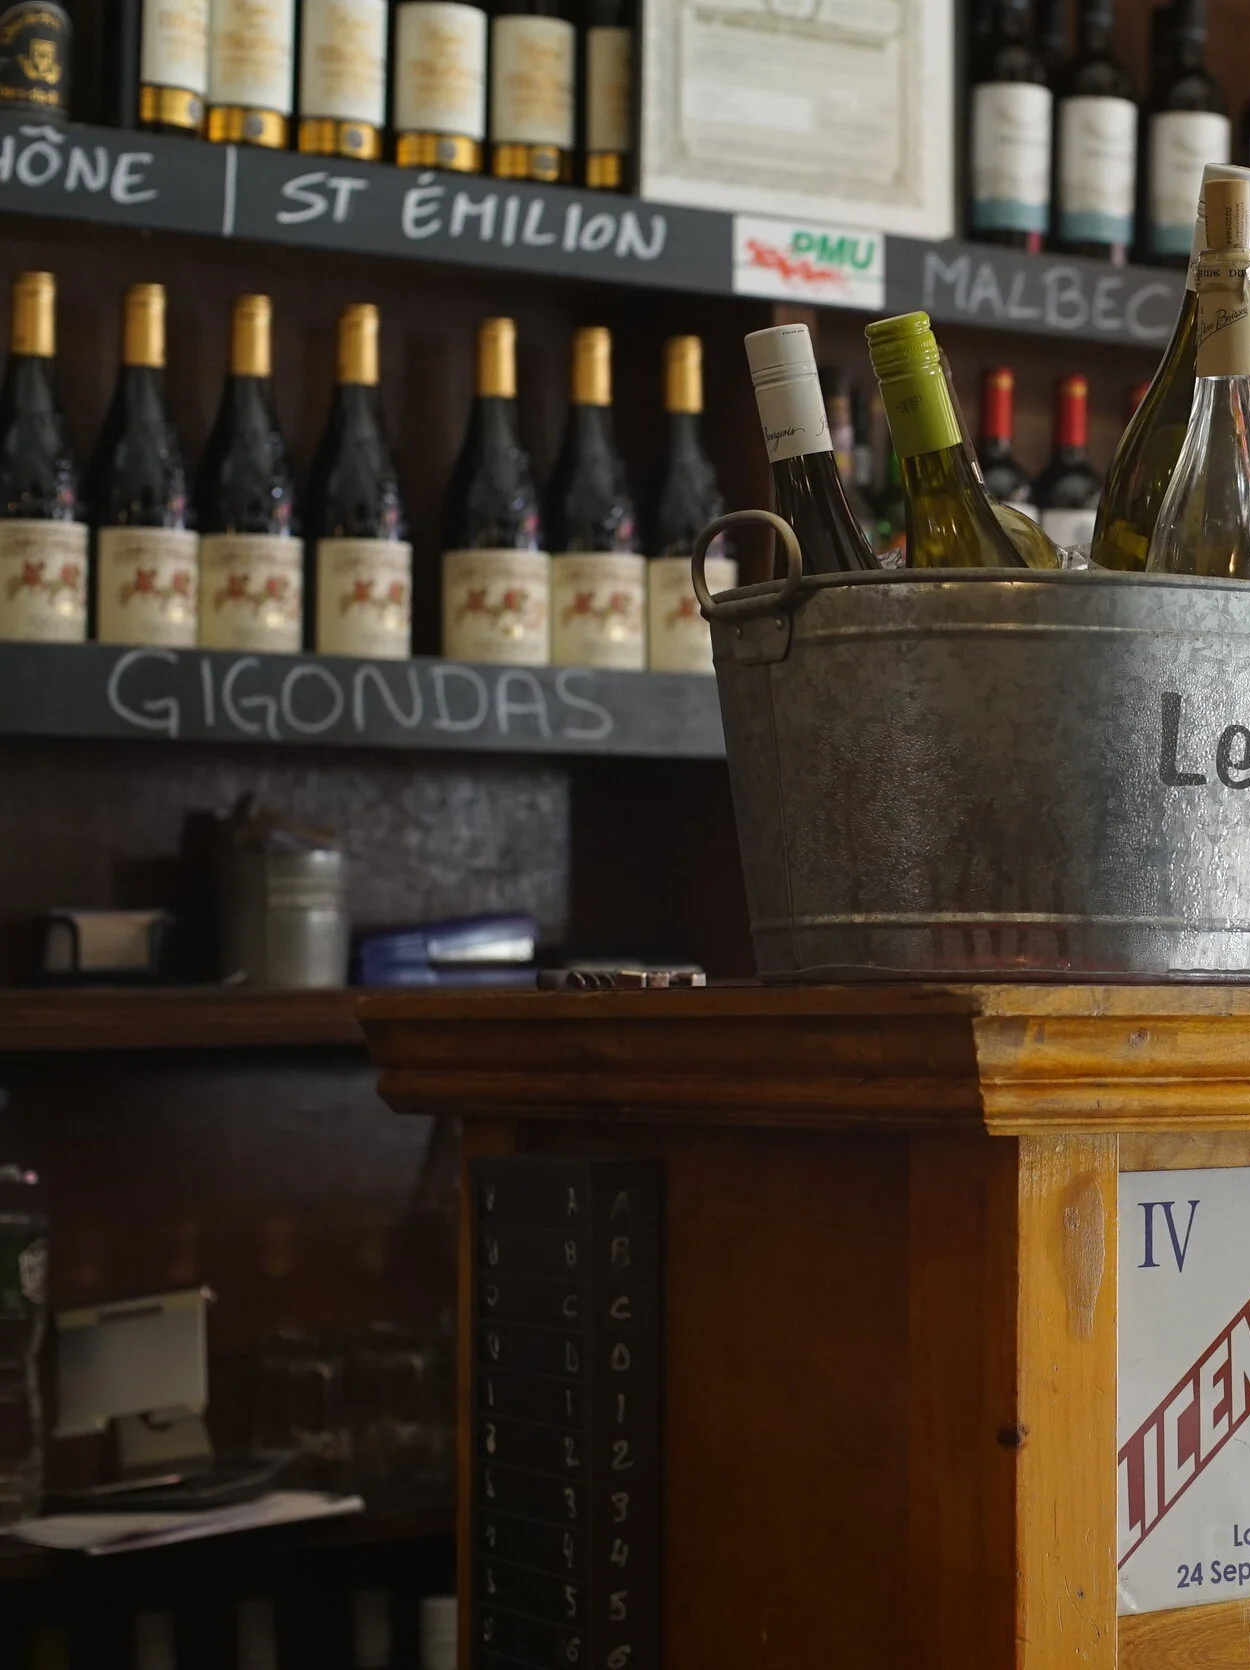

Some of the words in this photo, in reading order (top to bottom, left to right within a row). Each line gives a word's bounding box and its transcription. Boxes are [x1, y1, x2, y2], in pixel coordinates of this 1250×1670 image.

[276, 172, 368, 224] ST
[402, 171, 667, 261] ÉMILION
[792, 231, 876, 270] PMU
[922, 250, 1174, 340] MALBEC
[106, 648, 614, 740] GIGONDAS
[1137, 1199, 1200, 1274] IV
[610, 1295, 632, 1320] C
[616, 1392, 626, 1424] 1
[610, 1438, 635, 1471] 2
[610, 1490, 630, 1523] 3
[609, 1537, 630, 1568] 4
[1176, 1562, 1204, 1589] 24
[609, 1589, 629, 1622] 5
[607, 1644, 632, 1670] 6
